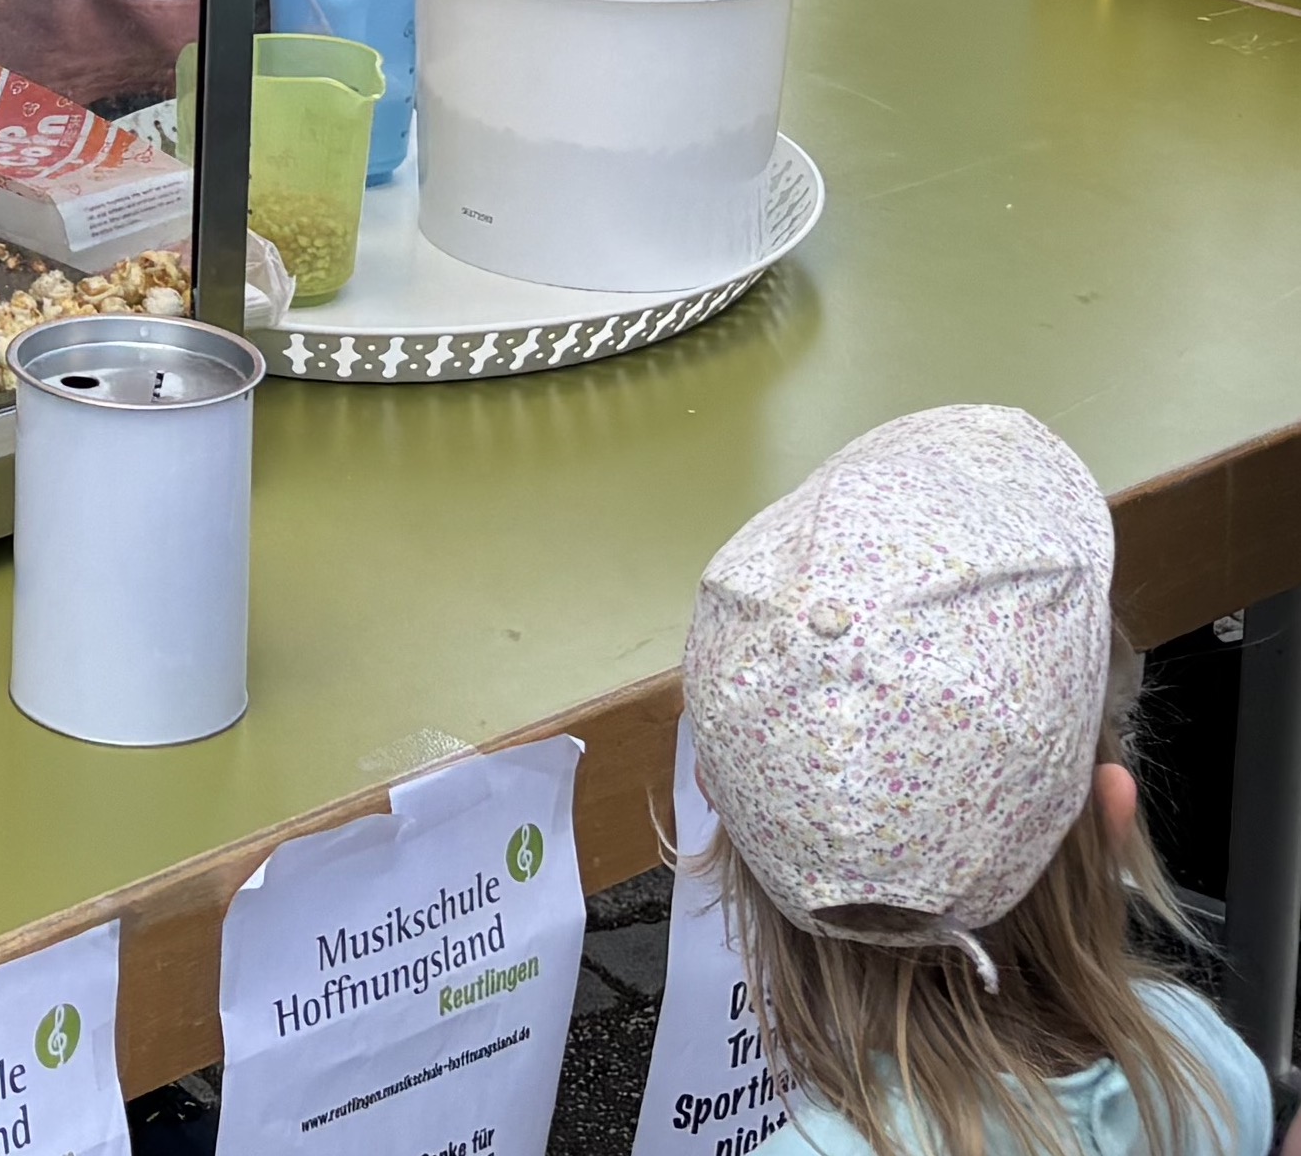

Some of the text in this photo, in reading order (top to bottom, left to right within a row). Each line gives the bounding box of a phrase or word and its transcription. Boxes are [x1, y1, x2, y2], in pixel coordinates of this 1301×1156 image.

[315, 871, 501, 972] Musikschule
[273, 912, 506, 1037] Hoffnungsland
[439, 955, 540, 1016] Reutlingen
[471, 1127, 495, 1154] für
